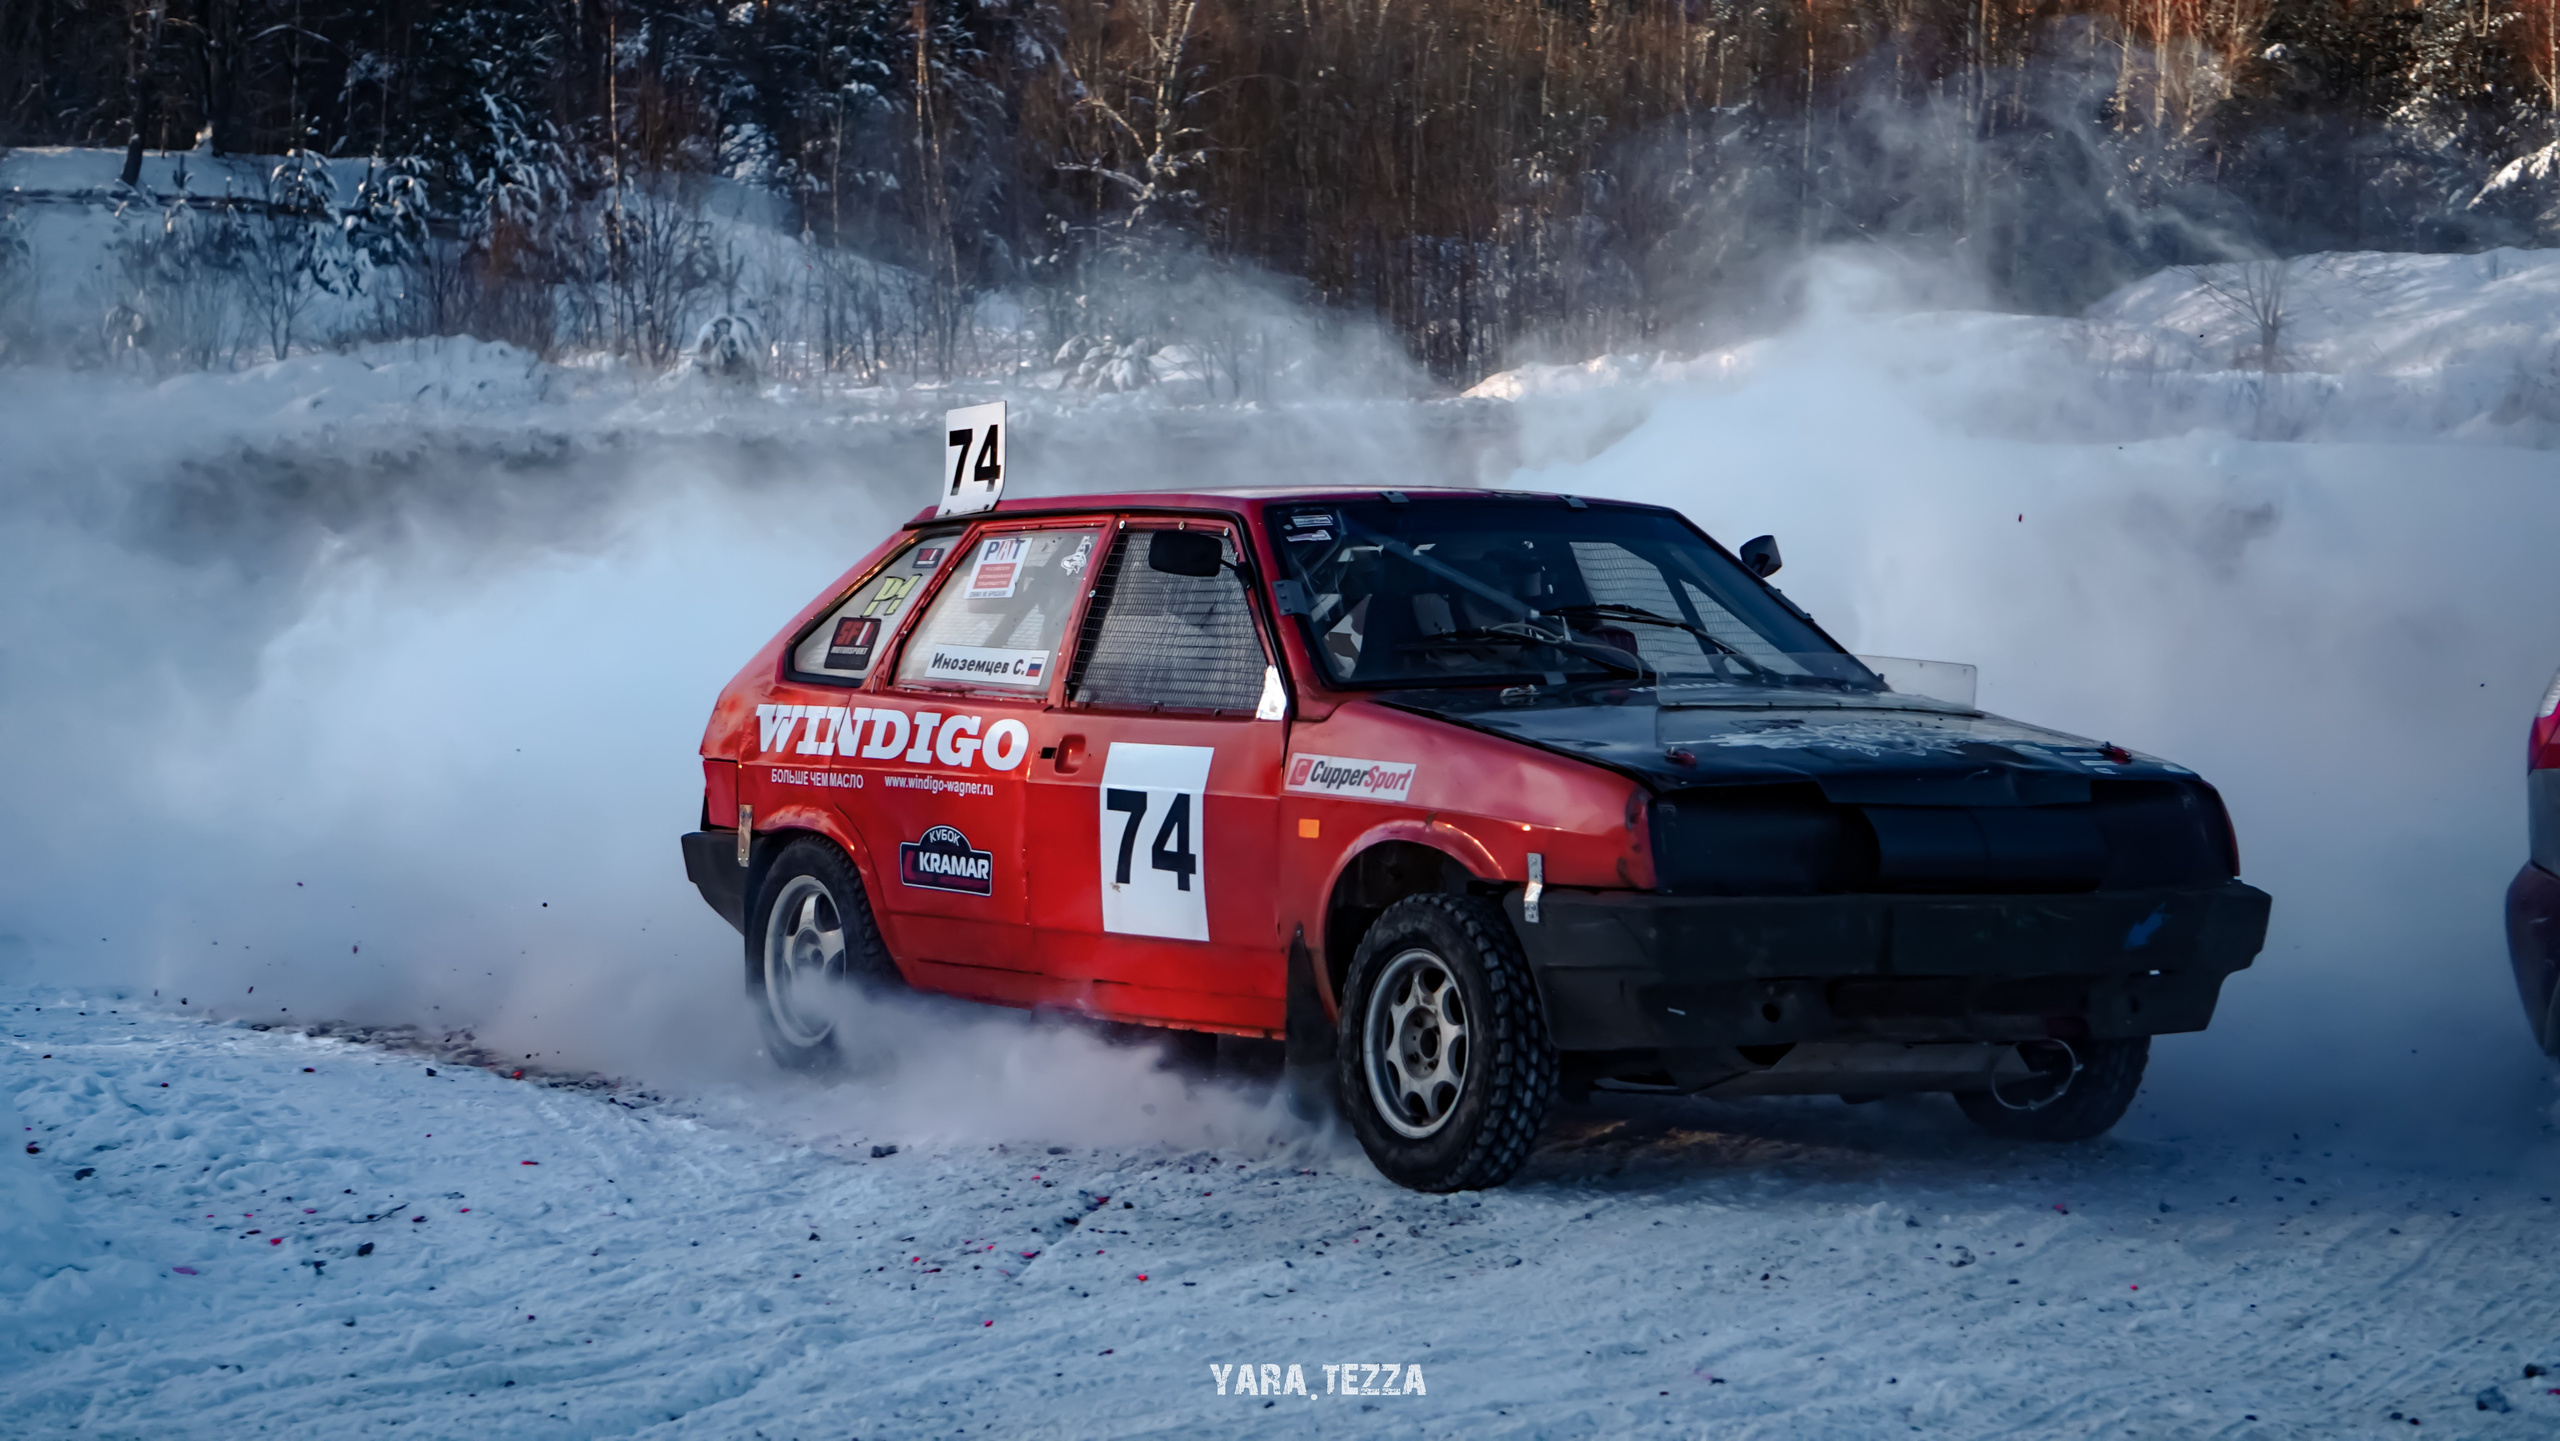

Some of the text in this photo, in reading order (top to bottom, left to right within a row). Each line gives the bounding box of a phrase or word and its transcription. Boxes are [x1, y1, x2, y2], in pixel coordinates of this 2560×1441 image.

[949, 424, 1001, 496] 74
[931, 653, 1009, 676] Иноземцев
[755, 703, 1030, 771] WINDIGO
[771, 768, 864, 789] БОЛЬШЕ ЧЕМ МАСЛО
[884, 773, 994, 796] www.windigo-wagner.ru
[1310, 760, 1412, 793] CupperSport
[929, 828, 961, 847] КУБОК
[1107, 788, 1196, 892] 74
[919, 851, 989, 880] KRAMAR
